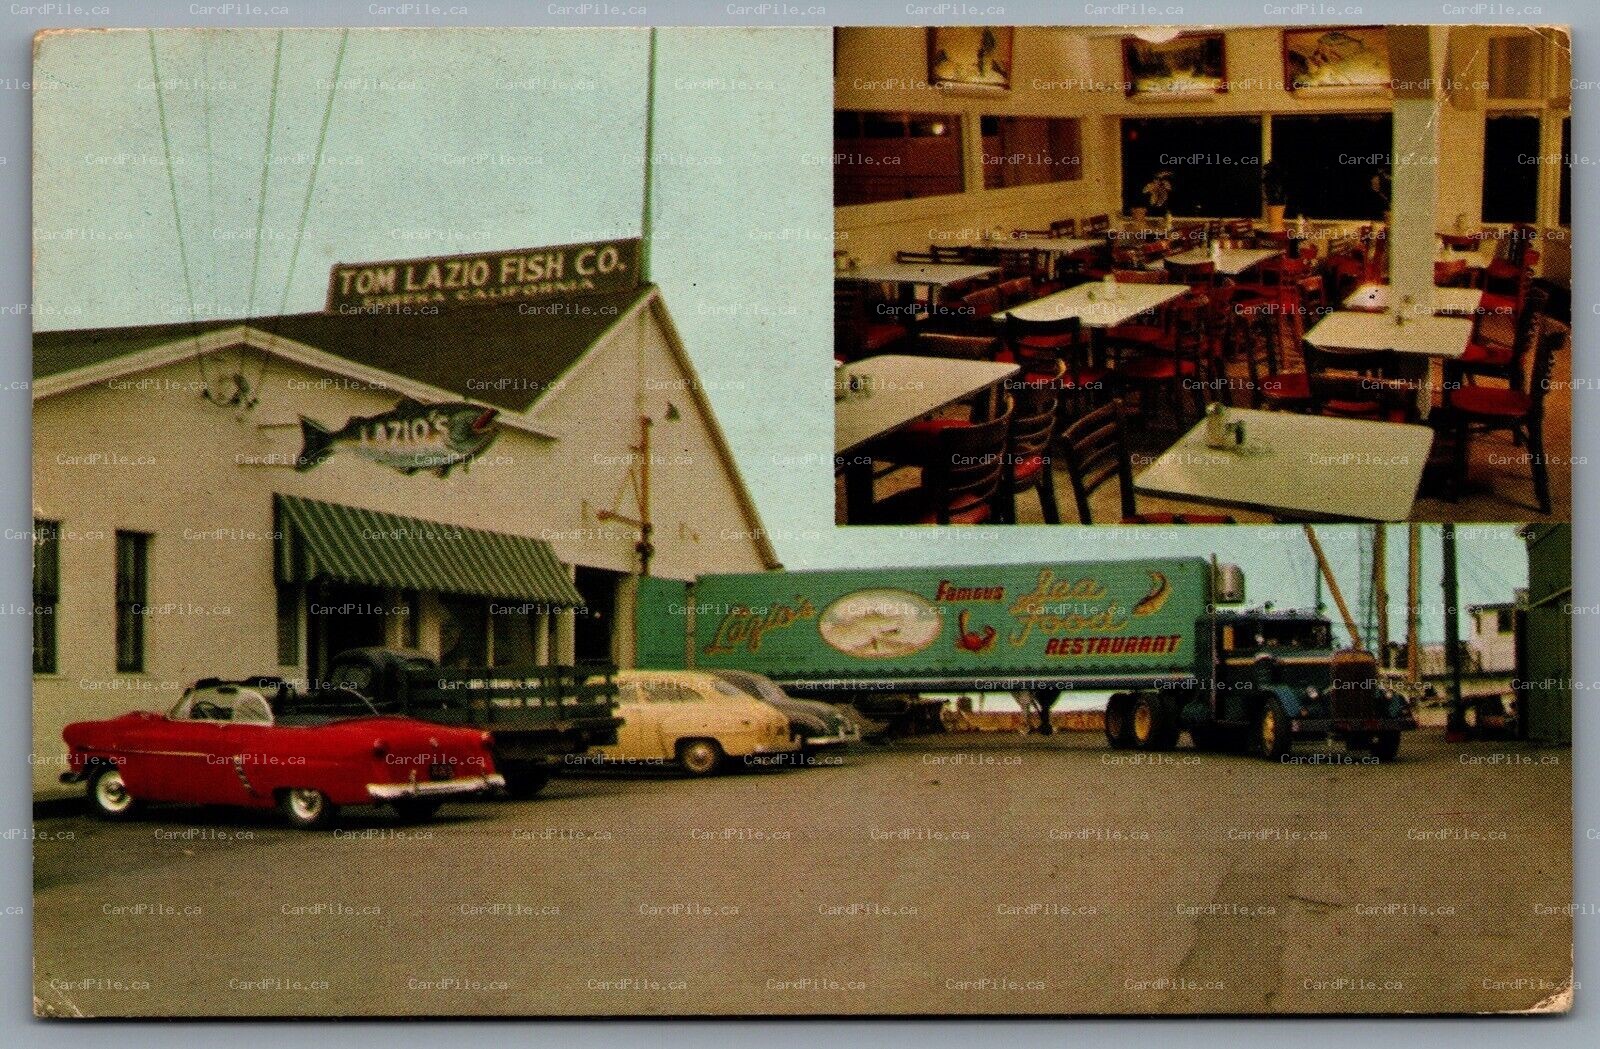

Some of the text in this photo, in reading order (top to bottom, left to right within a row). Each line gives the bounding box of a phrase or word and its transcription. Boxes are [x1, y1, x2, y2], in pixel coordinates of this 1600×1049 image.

[340, 246, 627, 295] TOM LAZIO FISH CO.
[359, 410, 450, 445] LAZIO'S
[1010, 567, 1109, 614] Sea
[1008, 600, 1129, 648] Food
[1045, 634, 1183, 657] RESTAURANT
